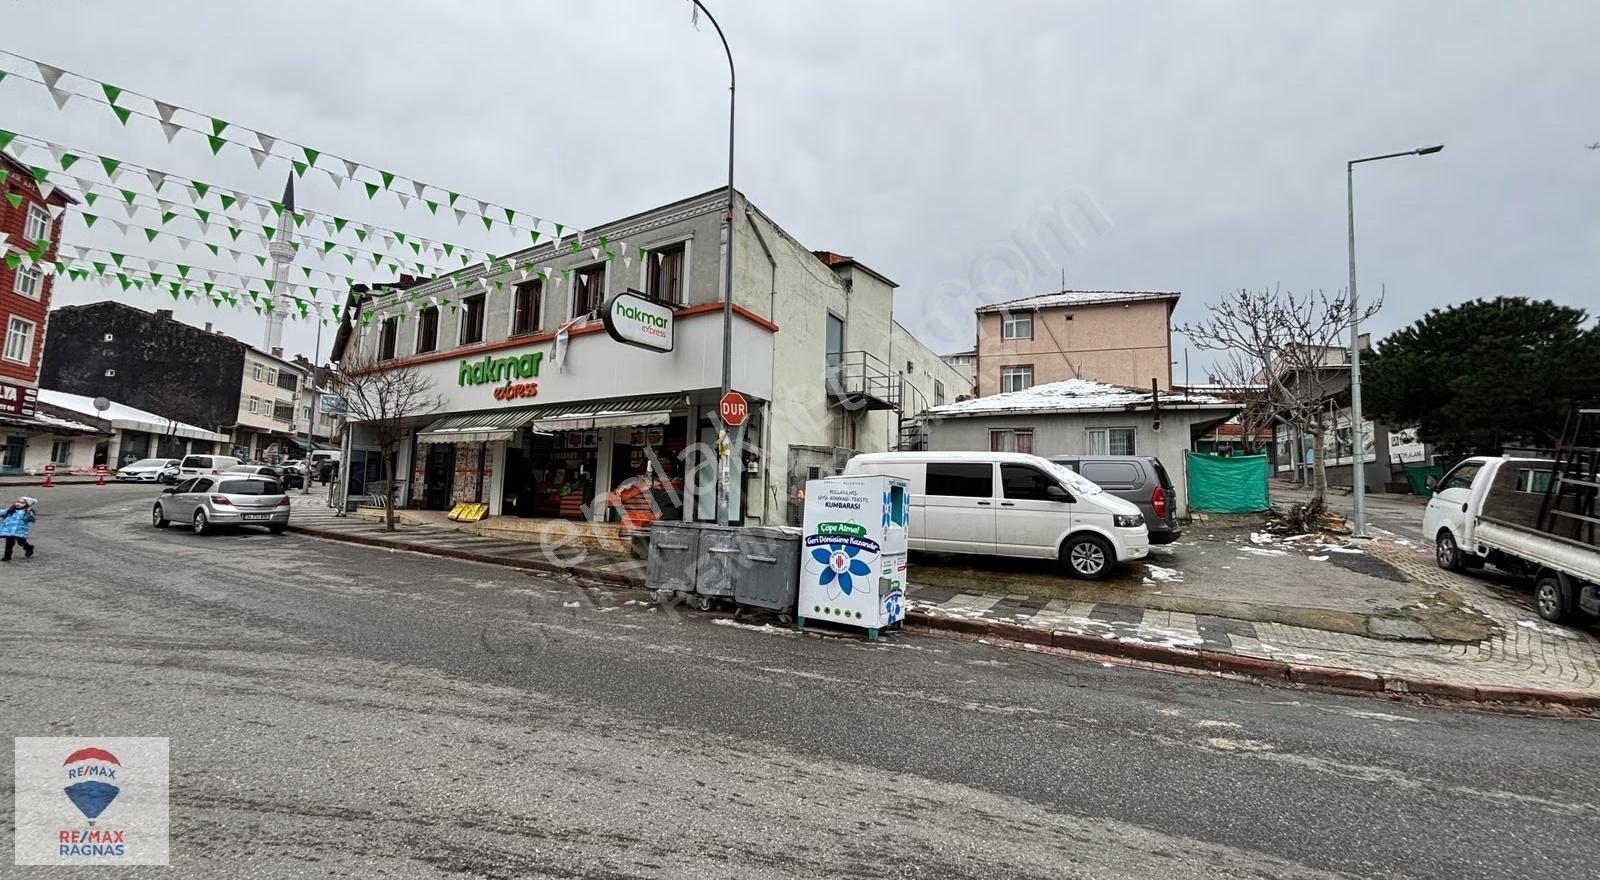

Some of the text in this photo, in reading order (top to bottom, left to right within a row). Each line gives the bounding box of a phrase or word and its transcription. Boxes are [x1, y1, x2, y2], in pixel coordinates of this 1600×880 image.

[616, 301, 668, 329] hakmar
[641, 325, 667, 338] express
[458, 352, 543, 387] hakmar
[493, 380, 538, 401] express
[722, 402, 746, 416] DUR
[825, 501, 861, 510] KUMBARASI
